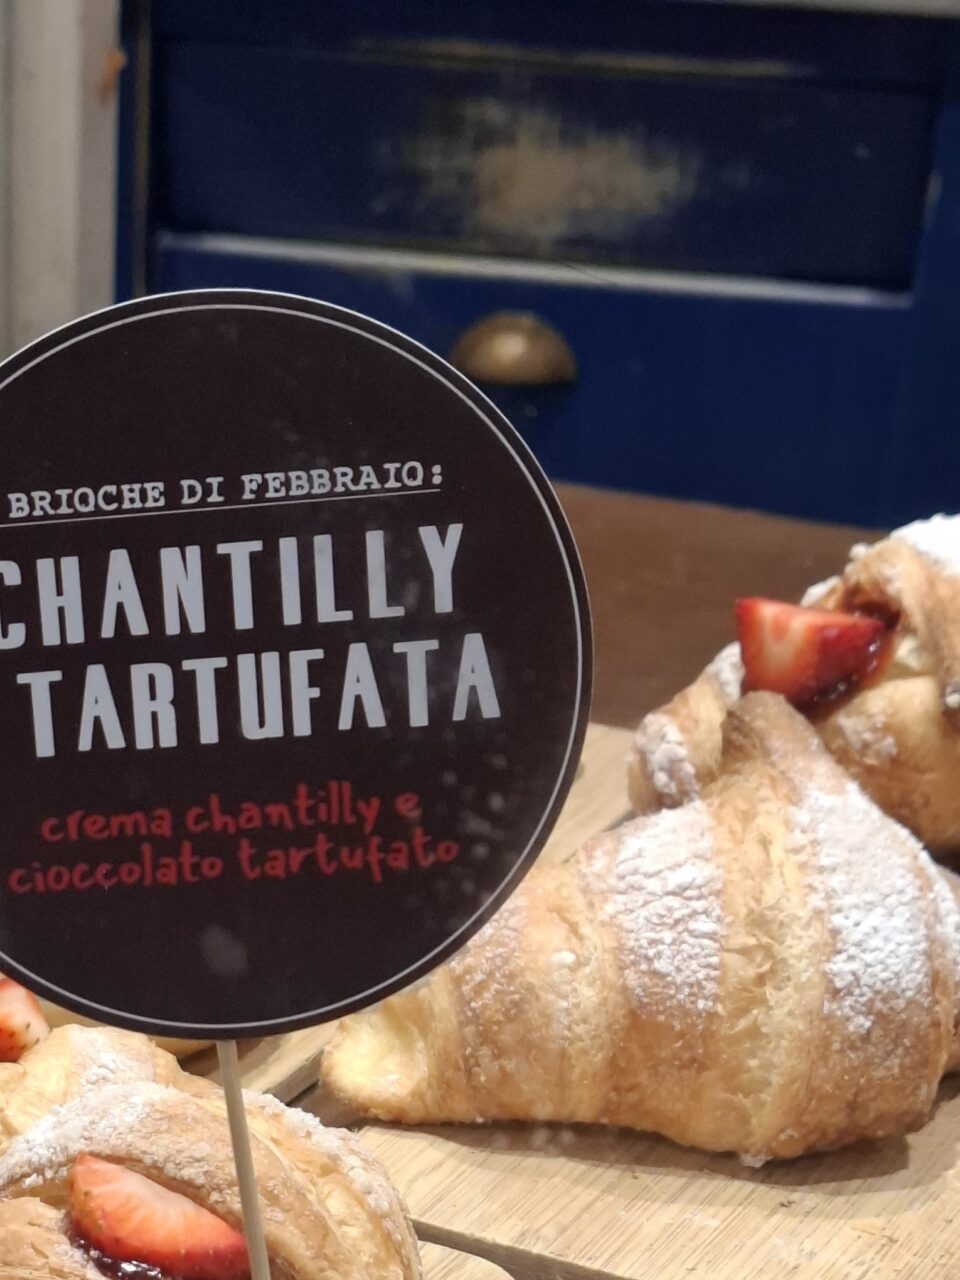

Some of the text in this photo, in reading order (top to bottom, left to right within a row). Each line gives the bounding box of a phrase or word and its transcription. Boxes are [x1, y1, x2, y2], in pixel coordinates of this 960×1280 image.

[7, 461, 443, 518] BRIOCHE DI FEBBRAIO:
[16, 633, 502, 758] TARTUFATA
[40, 779, 422, 842] crema chantilly e
[7, 825, 460, 893] cioccolato tartufato
